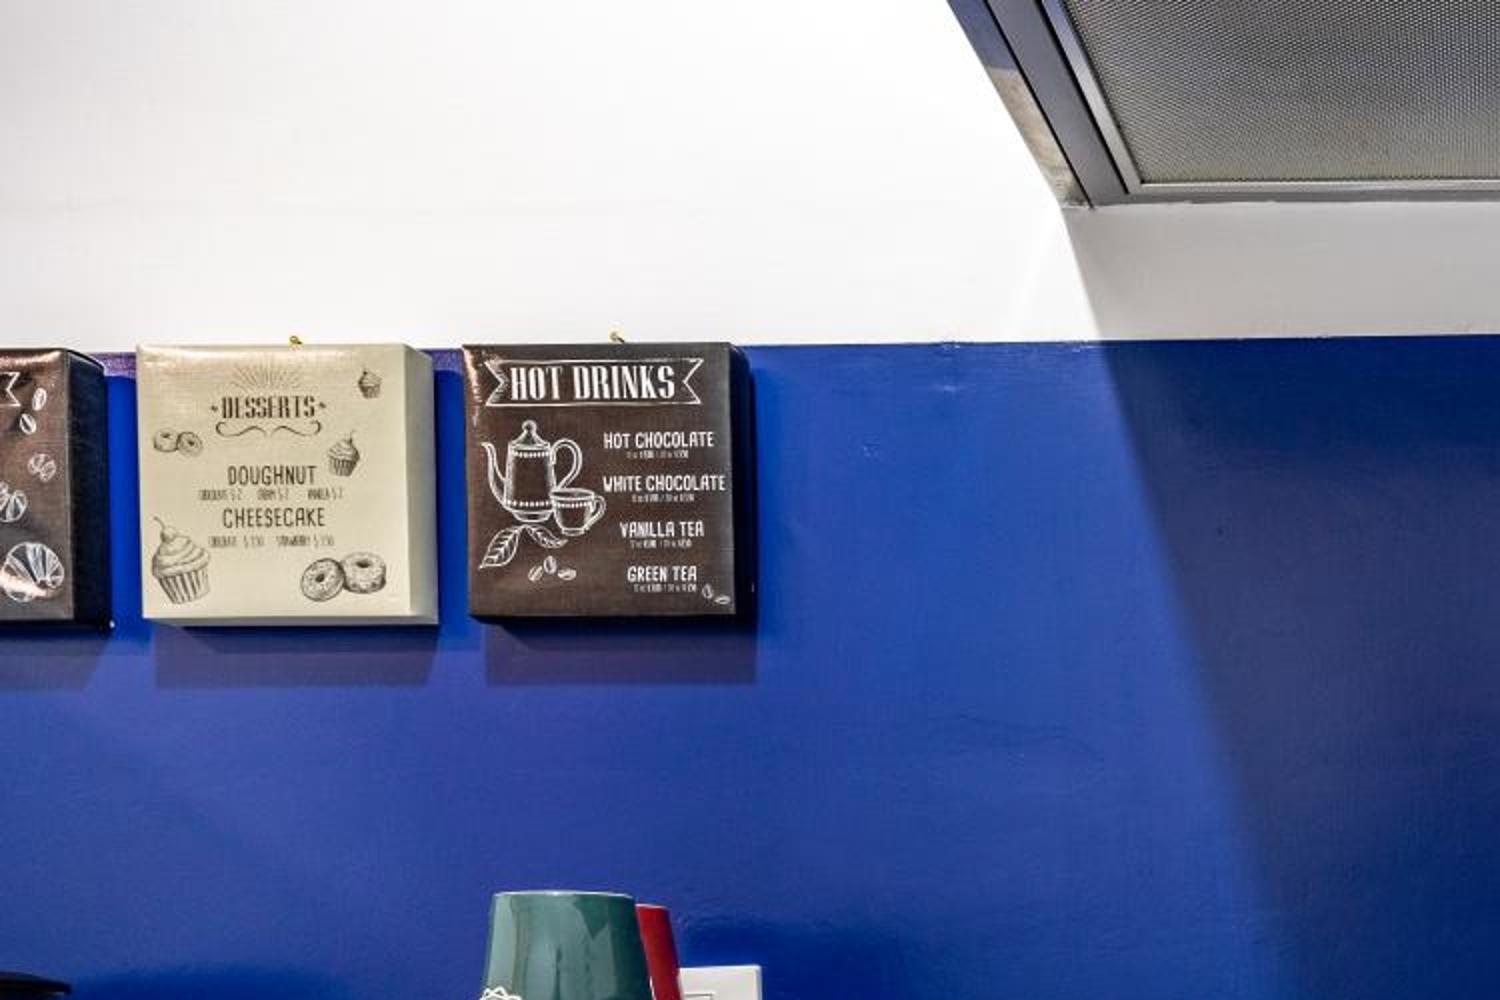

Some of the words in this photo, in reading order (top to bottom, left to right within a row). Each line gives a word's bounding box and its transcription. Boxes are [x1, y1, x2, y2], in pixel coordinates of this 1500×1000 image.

[510, 366, 563, 400] HOT
[574, 365, 675, 399] DRINKS
[221, 395, 316, 418] DESSERTS
[603, 431, 632, 449] HOT
[635, 431, 715, 449] CHOCOLATE
[227, 466, 317, 486] DOUGHNUT
[602, 475, 642, 492] WHITE
[645, 474, 726, 492] CHOCOLATE
[222, 506, 326, 529] CHEESECAKE
[619, 521, 675, 538] VANILLA
[679, 520, 705, 537] TEA
[627, 565, 668, 582] GREEN
[671, 565, 697, 582] TEA
